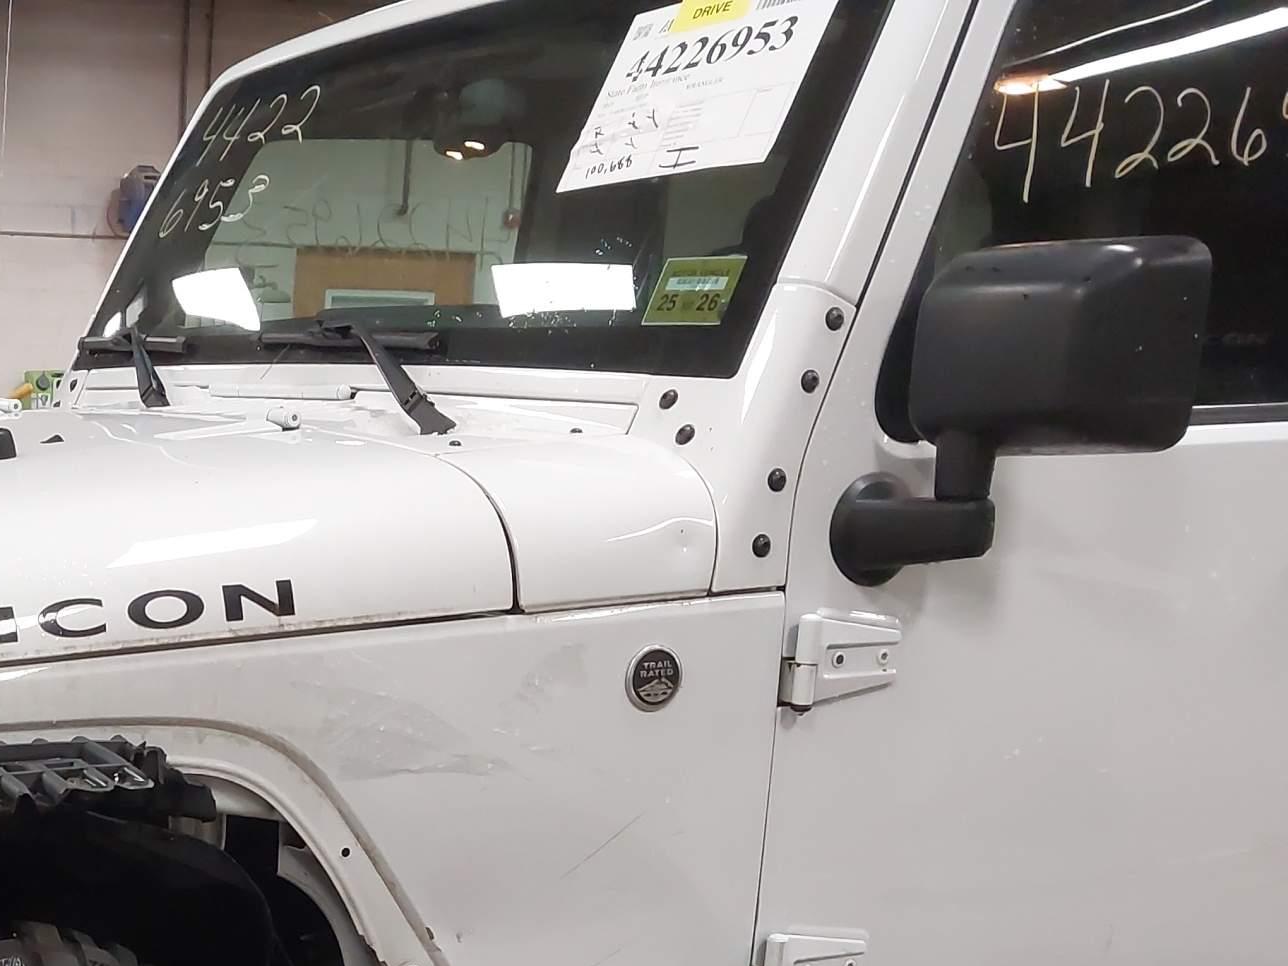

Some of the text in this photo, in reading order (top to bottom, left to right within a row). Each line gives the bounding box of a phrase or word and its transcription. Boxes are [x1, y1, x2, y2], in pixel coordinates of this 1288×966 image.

[692, 0, 732, 20] DRIVE
[626, 15, 799, 82] 44226953
[196, 85, 321, 167] 4422
[993, 78, 1288, 204] 44226
[158, 174, 270, 239] 6953
[656, 293, 680, 312] 25
[695, 292, 721, 312] 26
[639, 668, 674, 679] RATED
[642, 659, 673, 670] TRAIL
